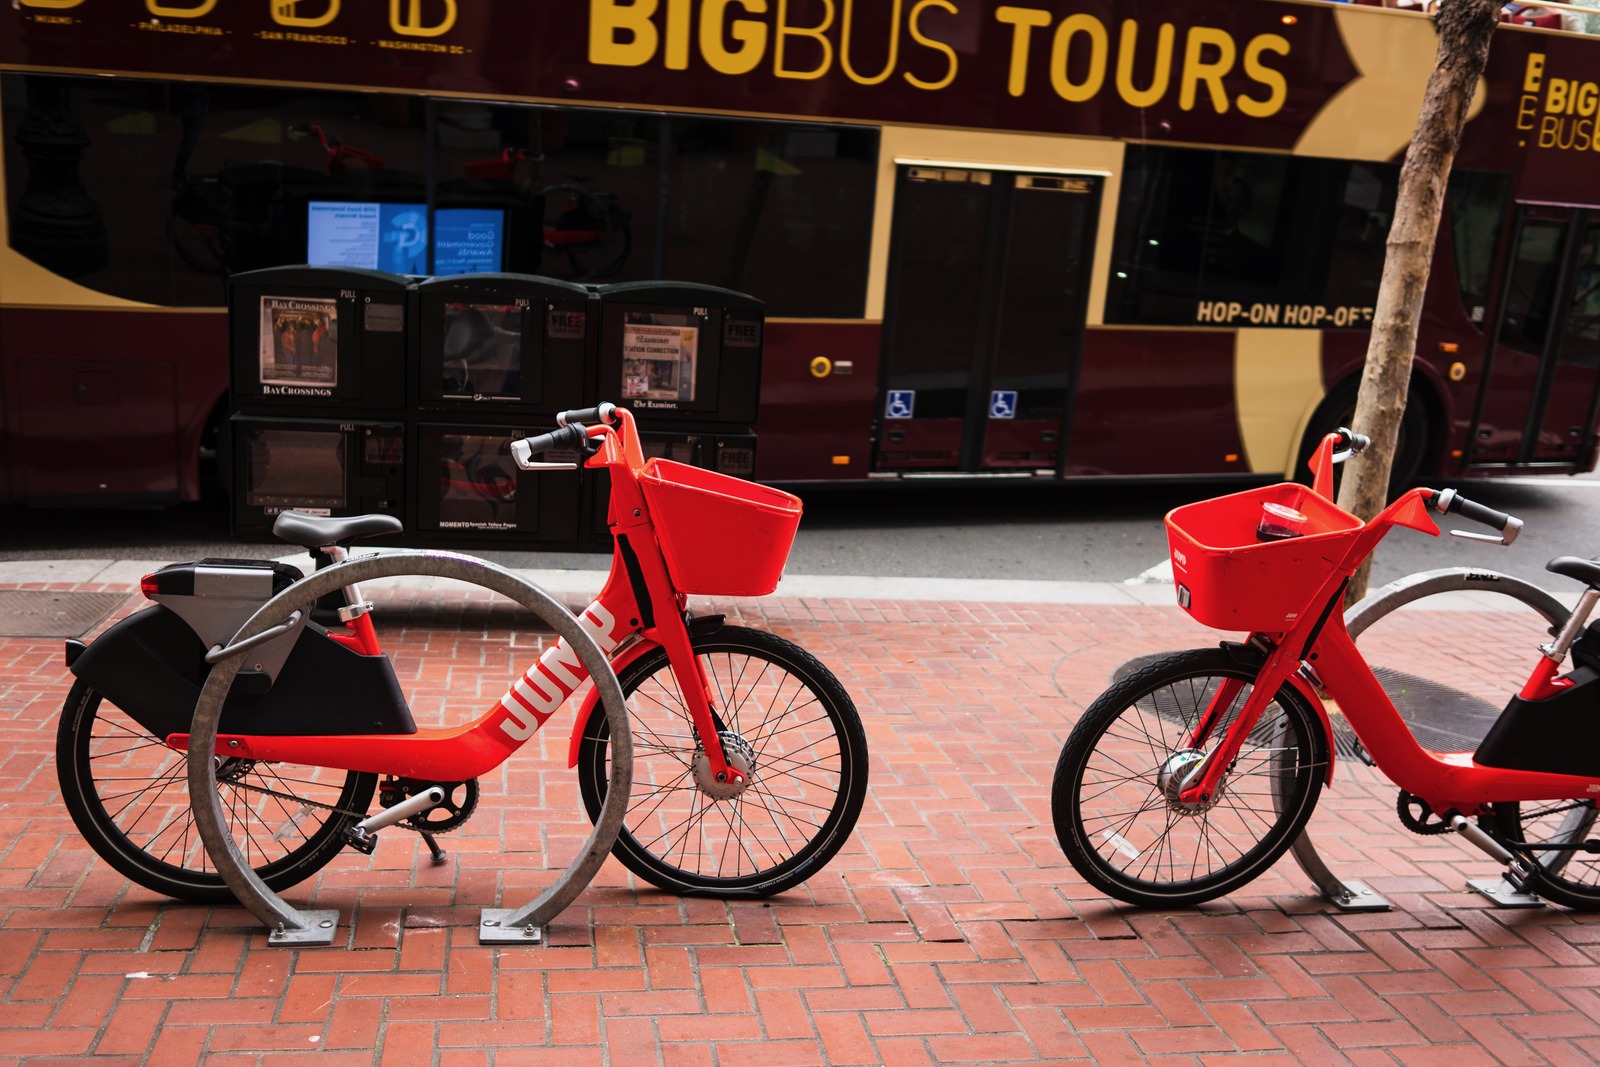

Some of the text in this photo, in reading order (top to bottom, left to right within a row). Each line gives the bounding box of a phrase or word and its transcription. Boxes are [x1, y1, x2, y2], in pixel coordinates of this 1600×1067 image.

[34, 15, 73, 26] MIAMI
[138, 20, 224, 37] PHILADELPHIA
[260, 30, 348, 46] SAN FRANCISCO
[378, 39, 465, 55] WASHINGTON DC
[995, 6, 1291, 119] TOURS
[1544, 77, 1600, 117] BIG
[1538, 115, 1594, 152] BUS
[340, 289, 357, 299] PULL
[1196, 301, 1281, 325] HOP-ON
[551, 314, 583, 327] FREE
[727, 324, 758, 337] FREE
[646, 347, 680, 355] CONNECTION
[633, 399, 647, 408] The
[339, 423, 357, 431] PULL
[721, 451, 750, 464] FREE
[439, 521, 470, 529] MOMENTO
[499, 600, 619, 741] JUMP
